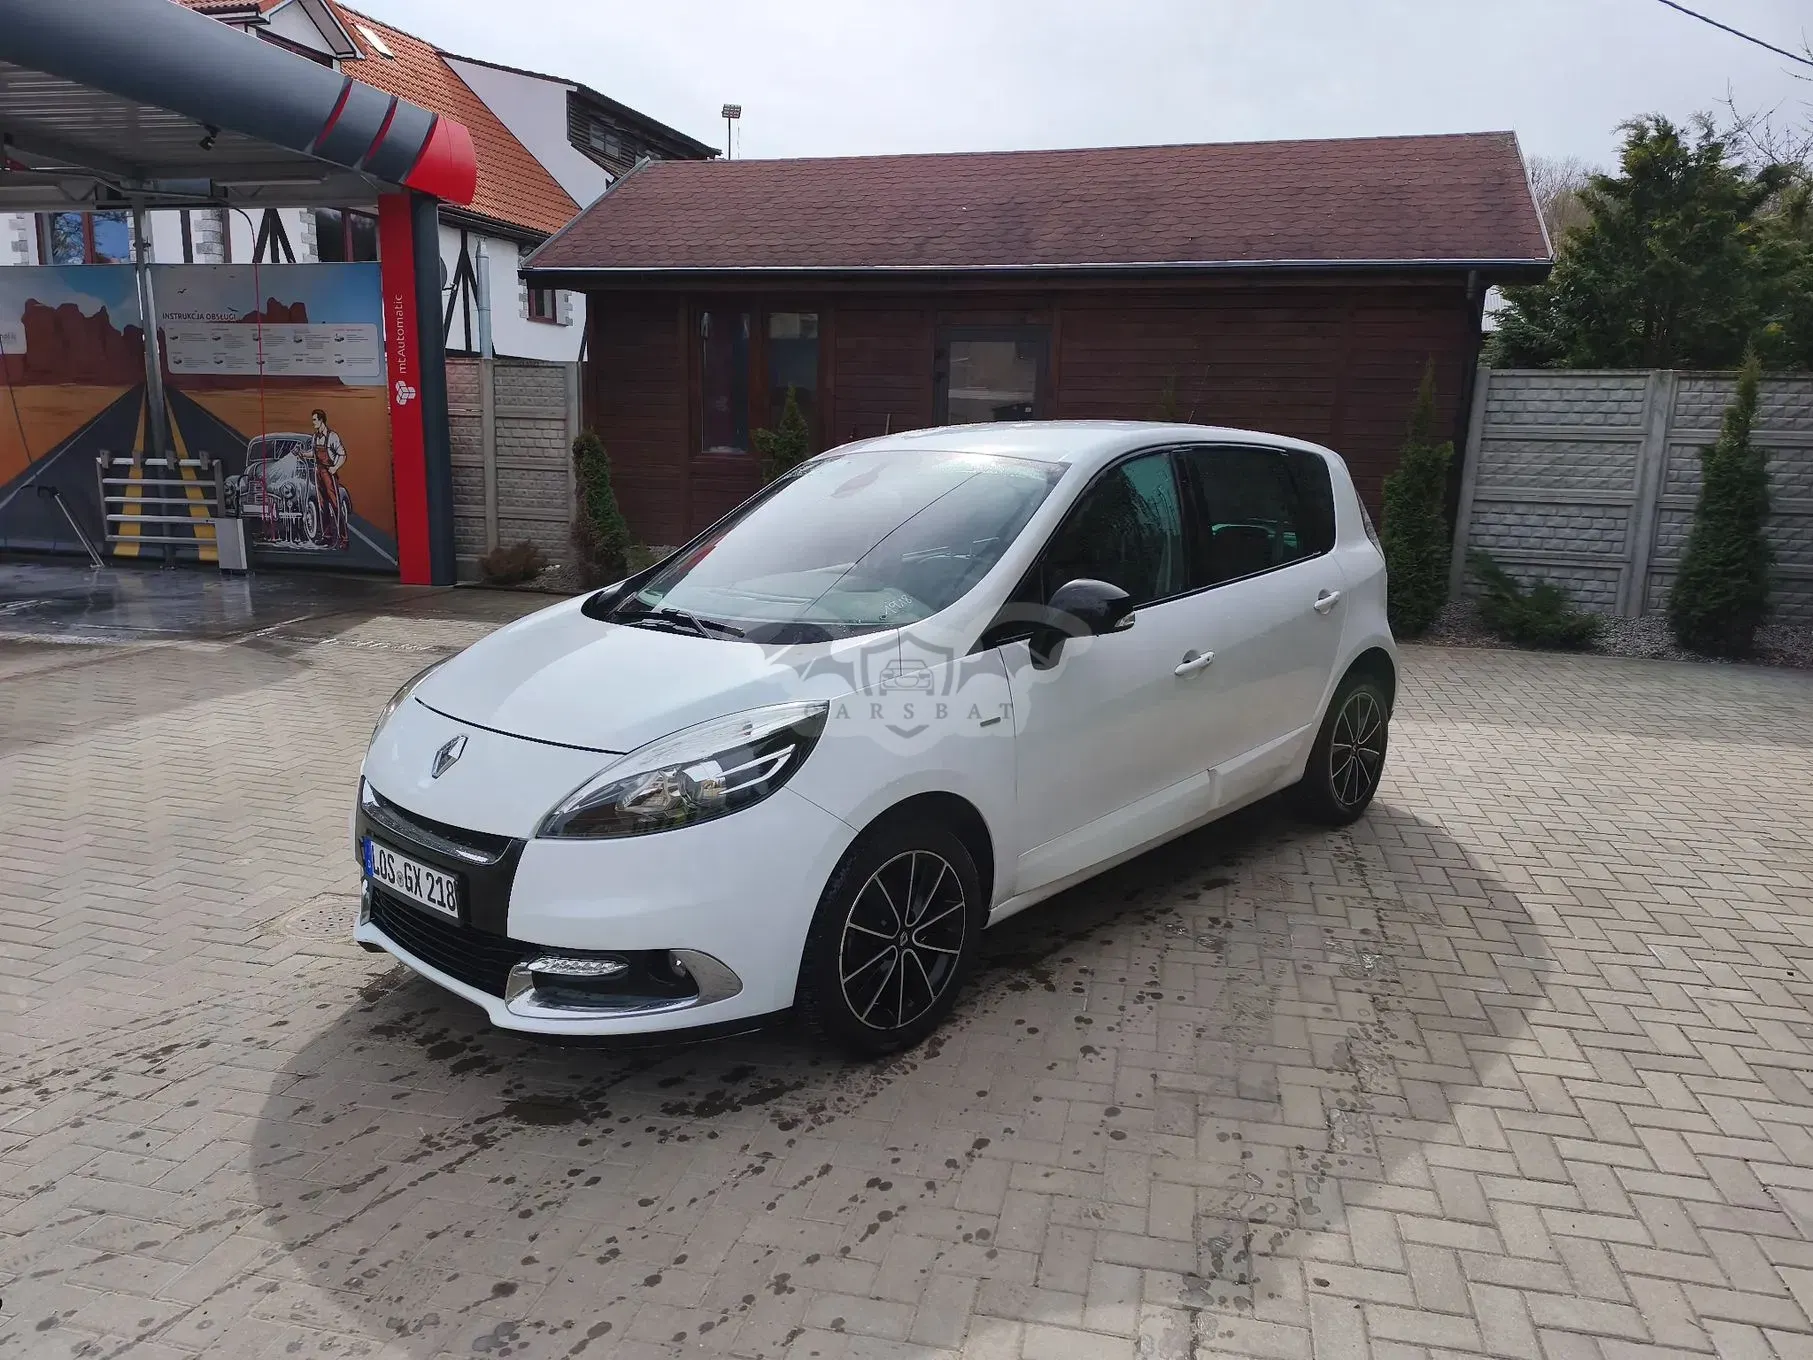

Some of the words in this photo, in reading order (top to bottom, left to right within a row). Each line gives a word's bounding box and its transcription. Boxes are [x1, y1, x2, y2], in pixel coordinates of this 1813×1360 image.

[162, 312, 205, 321] INSTRUKCJA
[206, 313, 237, 321] OBSŁUGI
[394, 294, 406, 374] mtAutomatic
[371, 844, 396, 885] LOS
[403, 861, 423, 899] GX
[425, 871, 456, 912] 218
